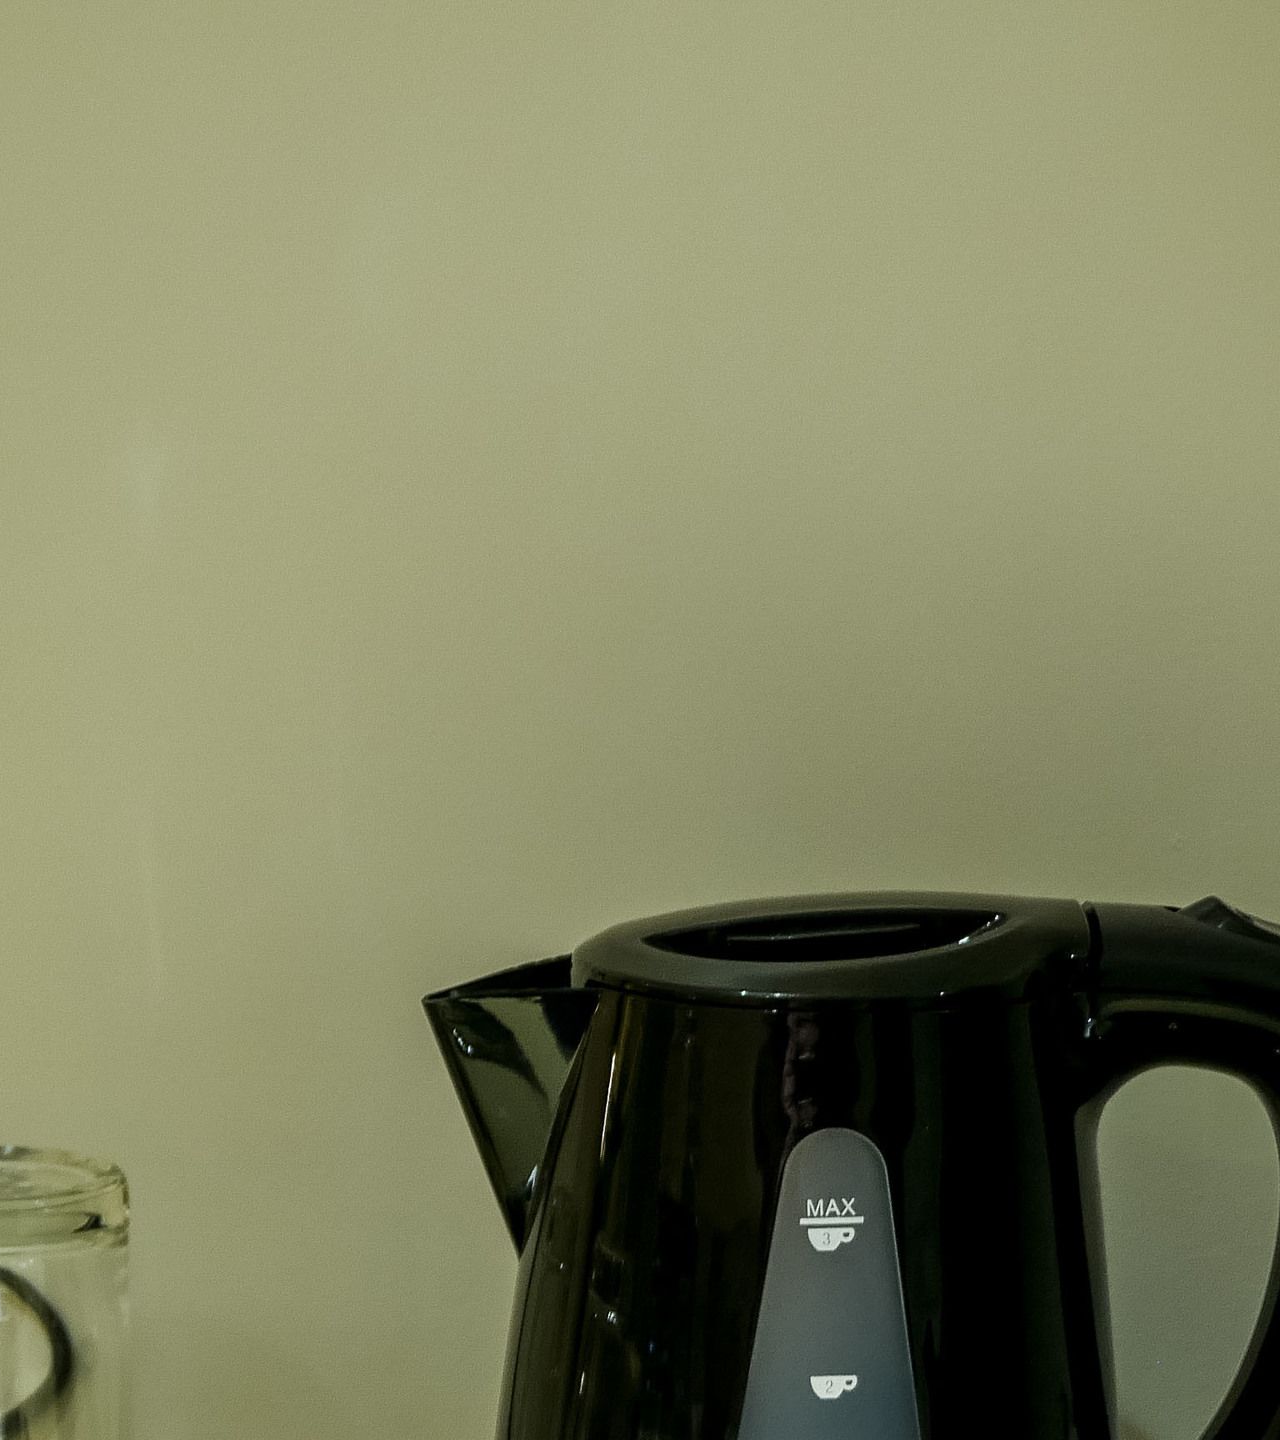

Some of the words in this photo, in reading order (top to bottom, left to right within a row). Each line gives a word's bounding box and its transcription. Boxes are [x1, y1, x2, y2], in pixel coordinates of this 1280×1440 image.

[806, 1197, 856, 1217] MAX
[822, 1231, 831, 1246] 3
[824, 1379, 834, 1393] 2
